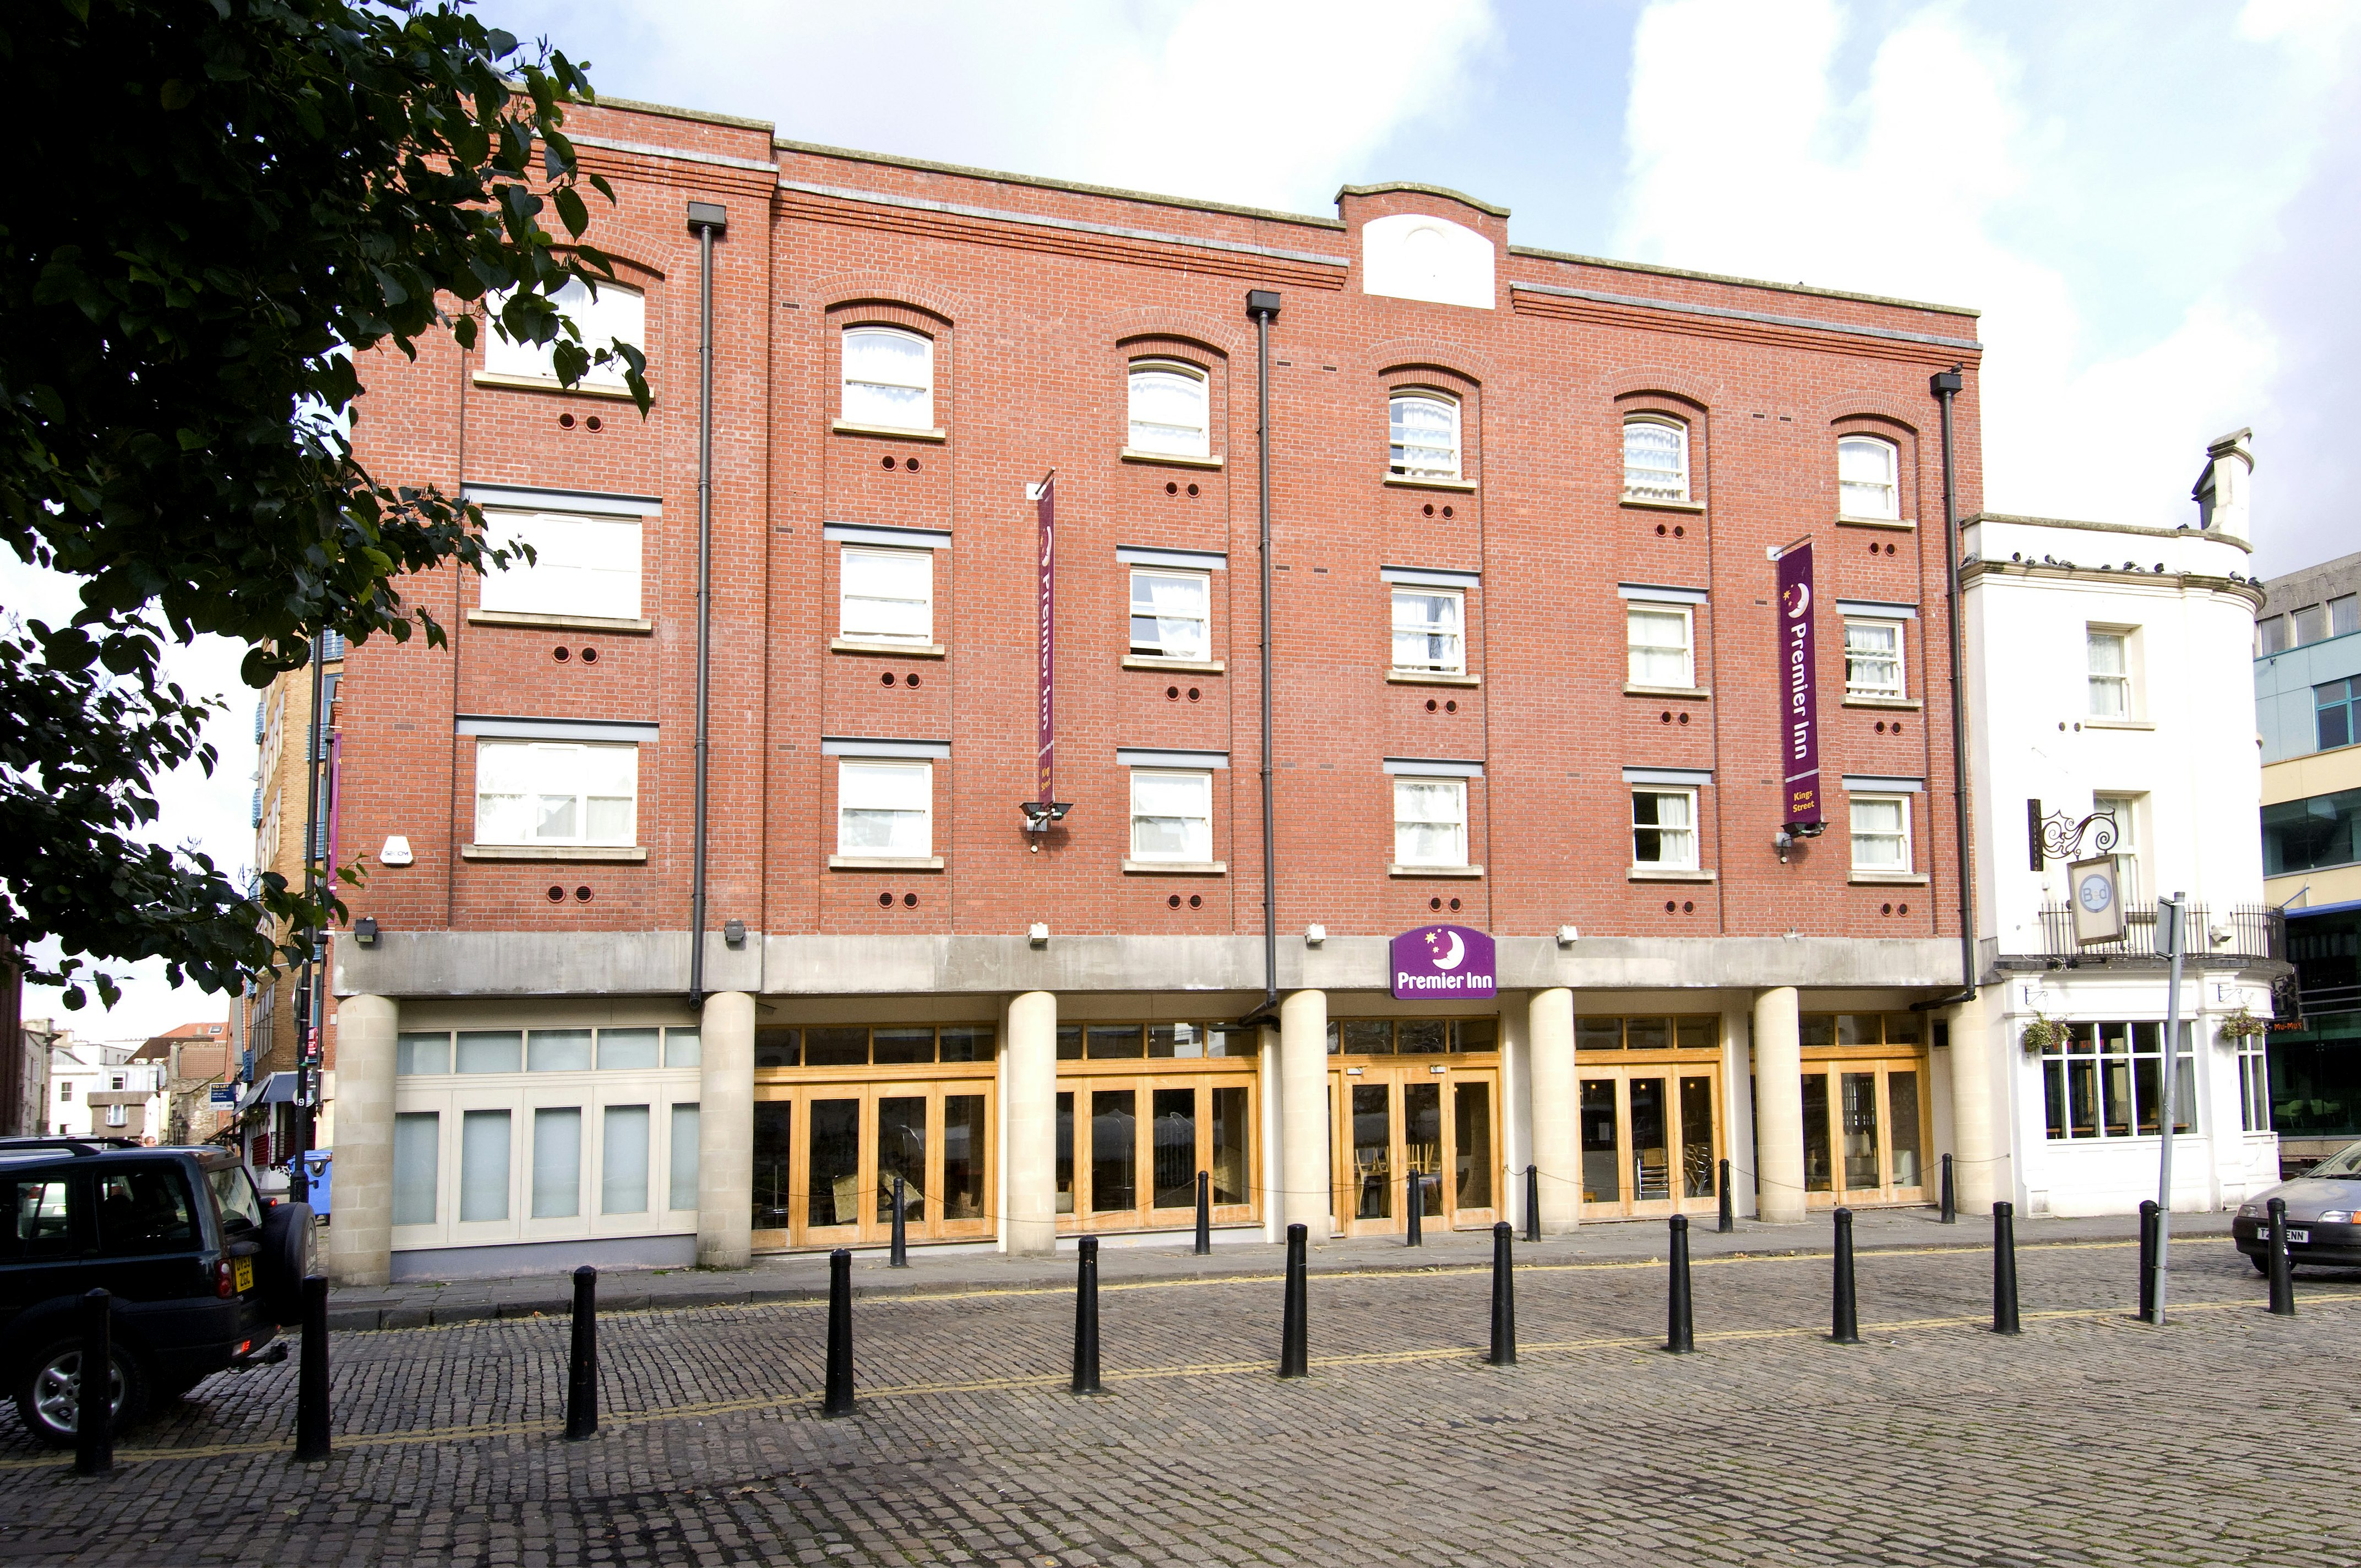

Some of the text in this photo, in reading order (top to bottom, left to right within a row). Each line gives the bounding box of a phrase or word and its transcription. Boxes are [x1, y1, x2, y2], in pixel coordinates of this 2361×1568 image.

[1791, 622, 1809, 760] Premier Inn
[1794, 790, 1813, 801] Kings
[1793, 800, 1815, 813] Street
[2083, 884, 2107, 902] Bed
[1397, 972, 1493, 989] Premier Inn
